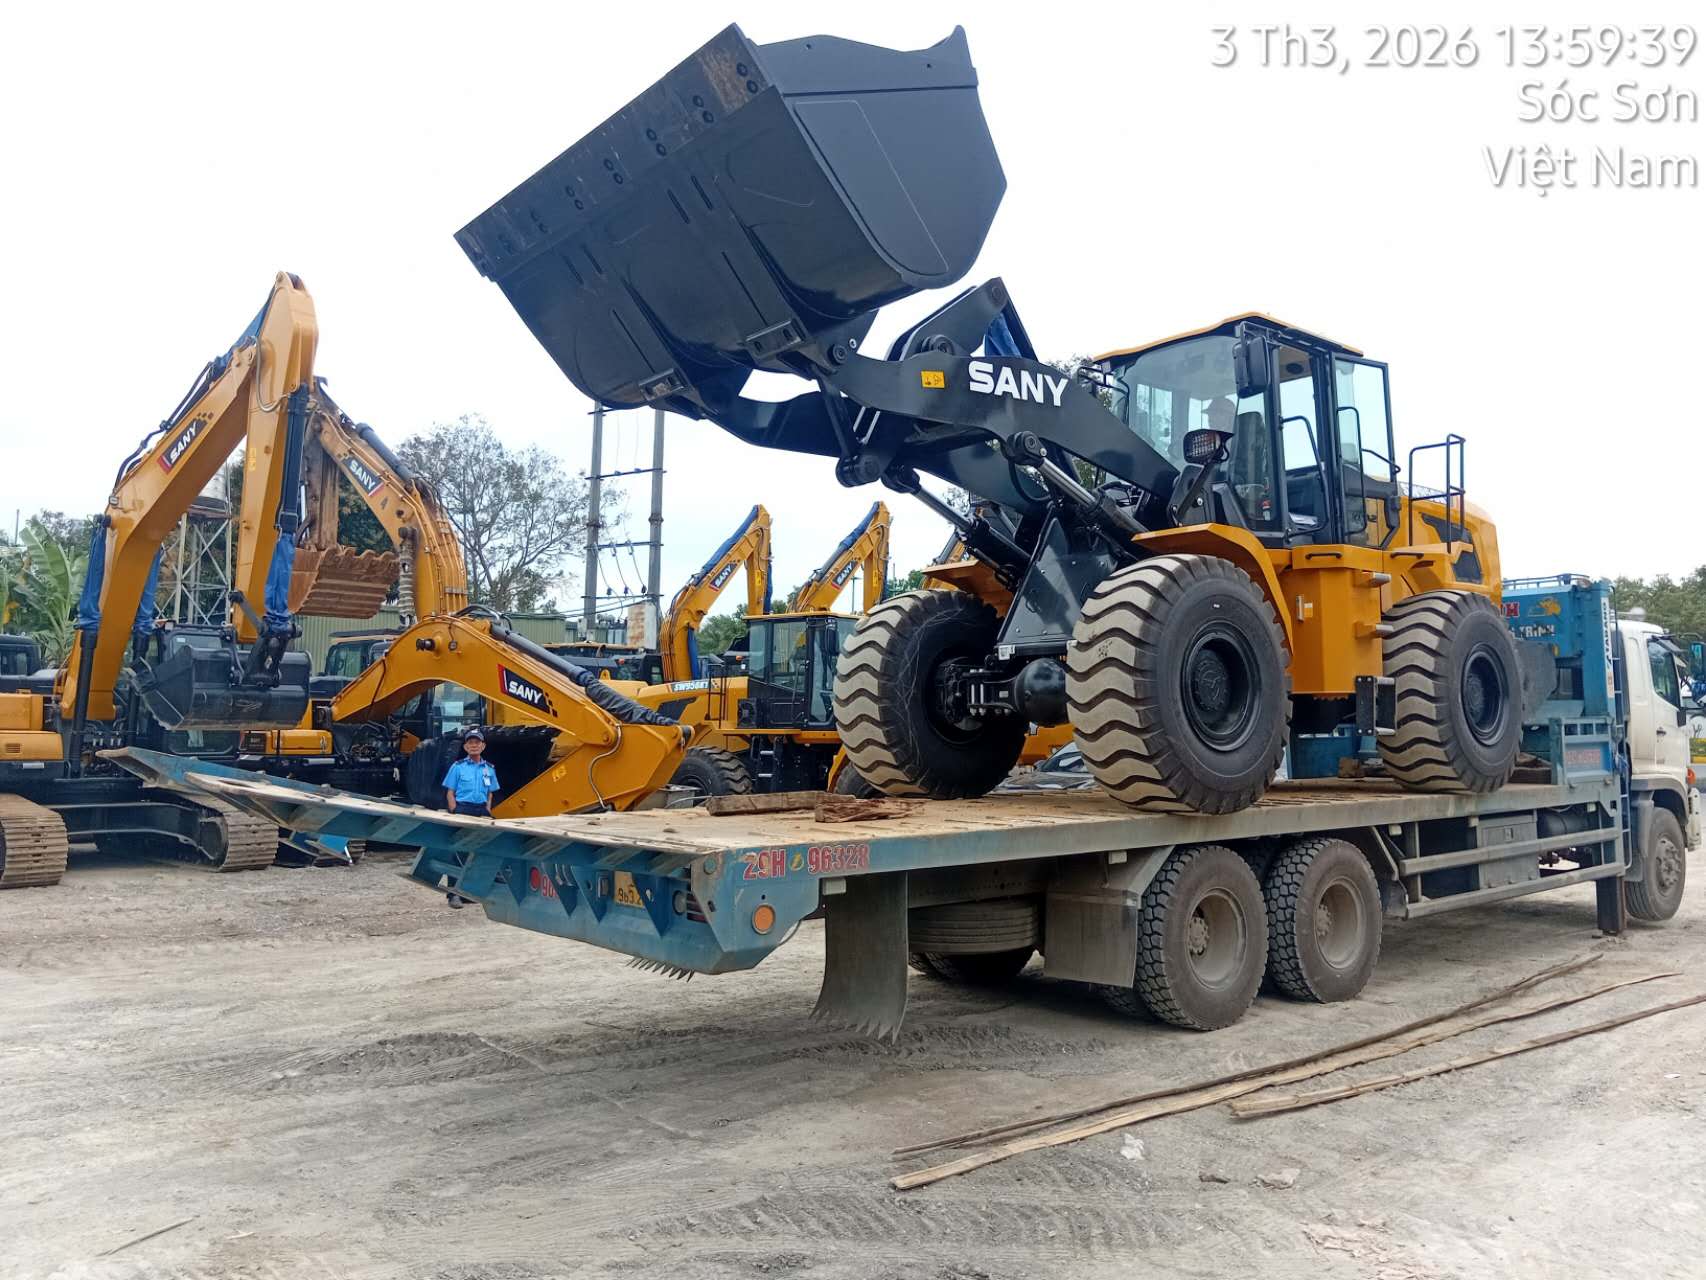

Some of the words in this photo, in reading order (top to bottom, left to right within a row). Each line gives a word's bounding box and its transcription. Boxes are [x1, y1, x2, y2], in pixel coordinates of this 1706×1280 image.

[968, 360, 1069, 407] SANY
[168, 422, 199, 464] SANY
[349, 459, 378, 491] SANY
[714, 565, 733, 588] SANY
[837, 562, 854, 585] SANY
[508, 680, 543, 704] SANY
[743, 849, 786, 880] 29H
